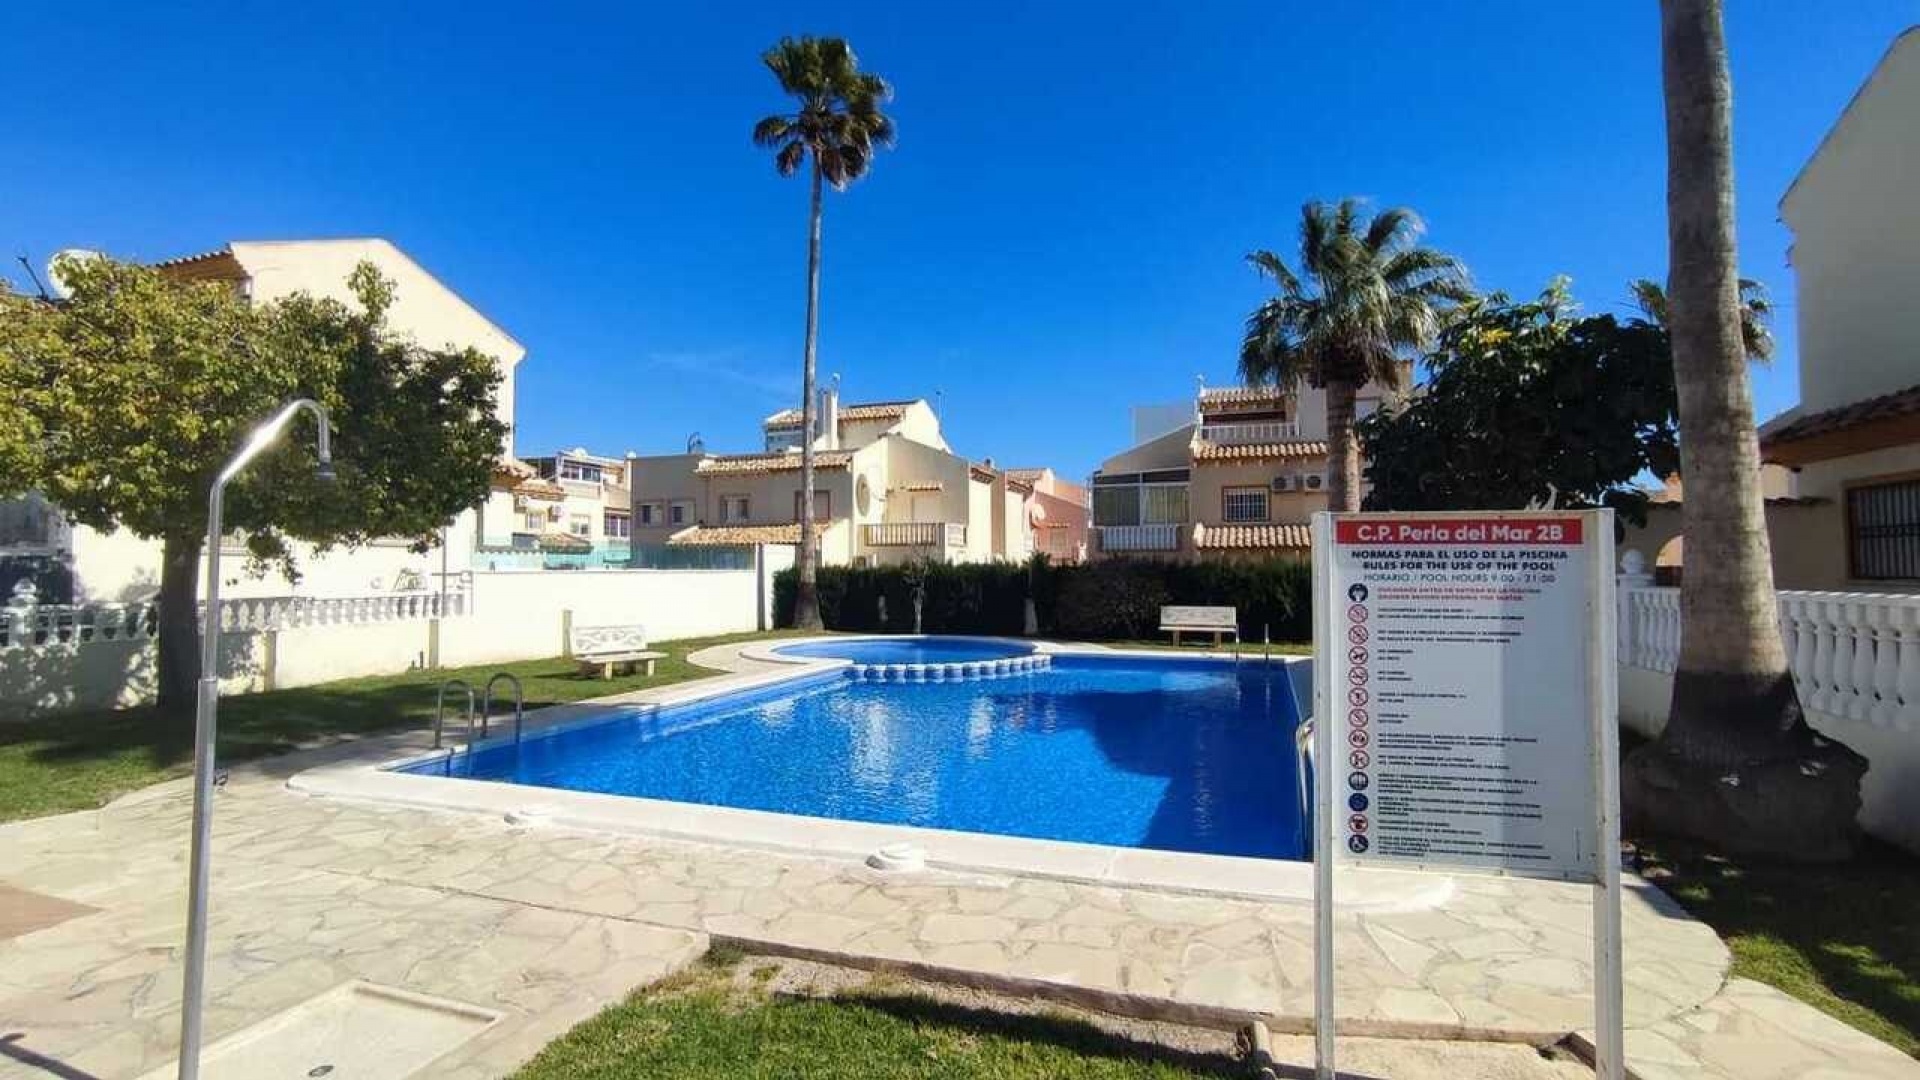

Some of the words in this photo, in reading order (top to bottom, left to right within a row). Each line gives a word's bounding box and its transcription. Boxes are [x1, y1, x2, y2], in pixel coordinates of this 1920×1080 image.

[1358, 525, 1393, 541] C.P.
[1399, 524, 1449, 541] Perla
[1454, 523, 1486, 541] del
[1491, 524, 1533, 541] Mar
[1536, 524, 1564, 541] 2B
[1351, 550, 1401, 559] NORMAS
[1404, 550, 1434, 559] PARA
[1438, 550, 1450, 559] EL
[1453, 550, 1478, 559] USO
[1482, 550, 1496, 559] DE
[1501, 550, 1516, 559] LA
[1519, 550, 1568, 560] PISCINA
[1362, 561, 1397, 570] RULES
[1400, 561, 1423, 570] FOR
[1426, 561, 1446, 570] THE
[1451, 561, 1472, 570] USE
[1476, 561, 1491, 570] OF
[1496, 561, 1518, 570] THE
[1521, 561, 1555, 570] POOL
